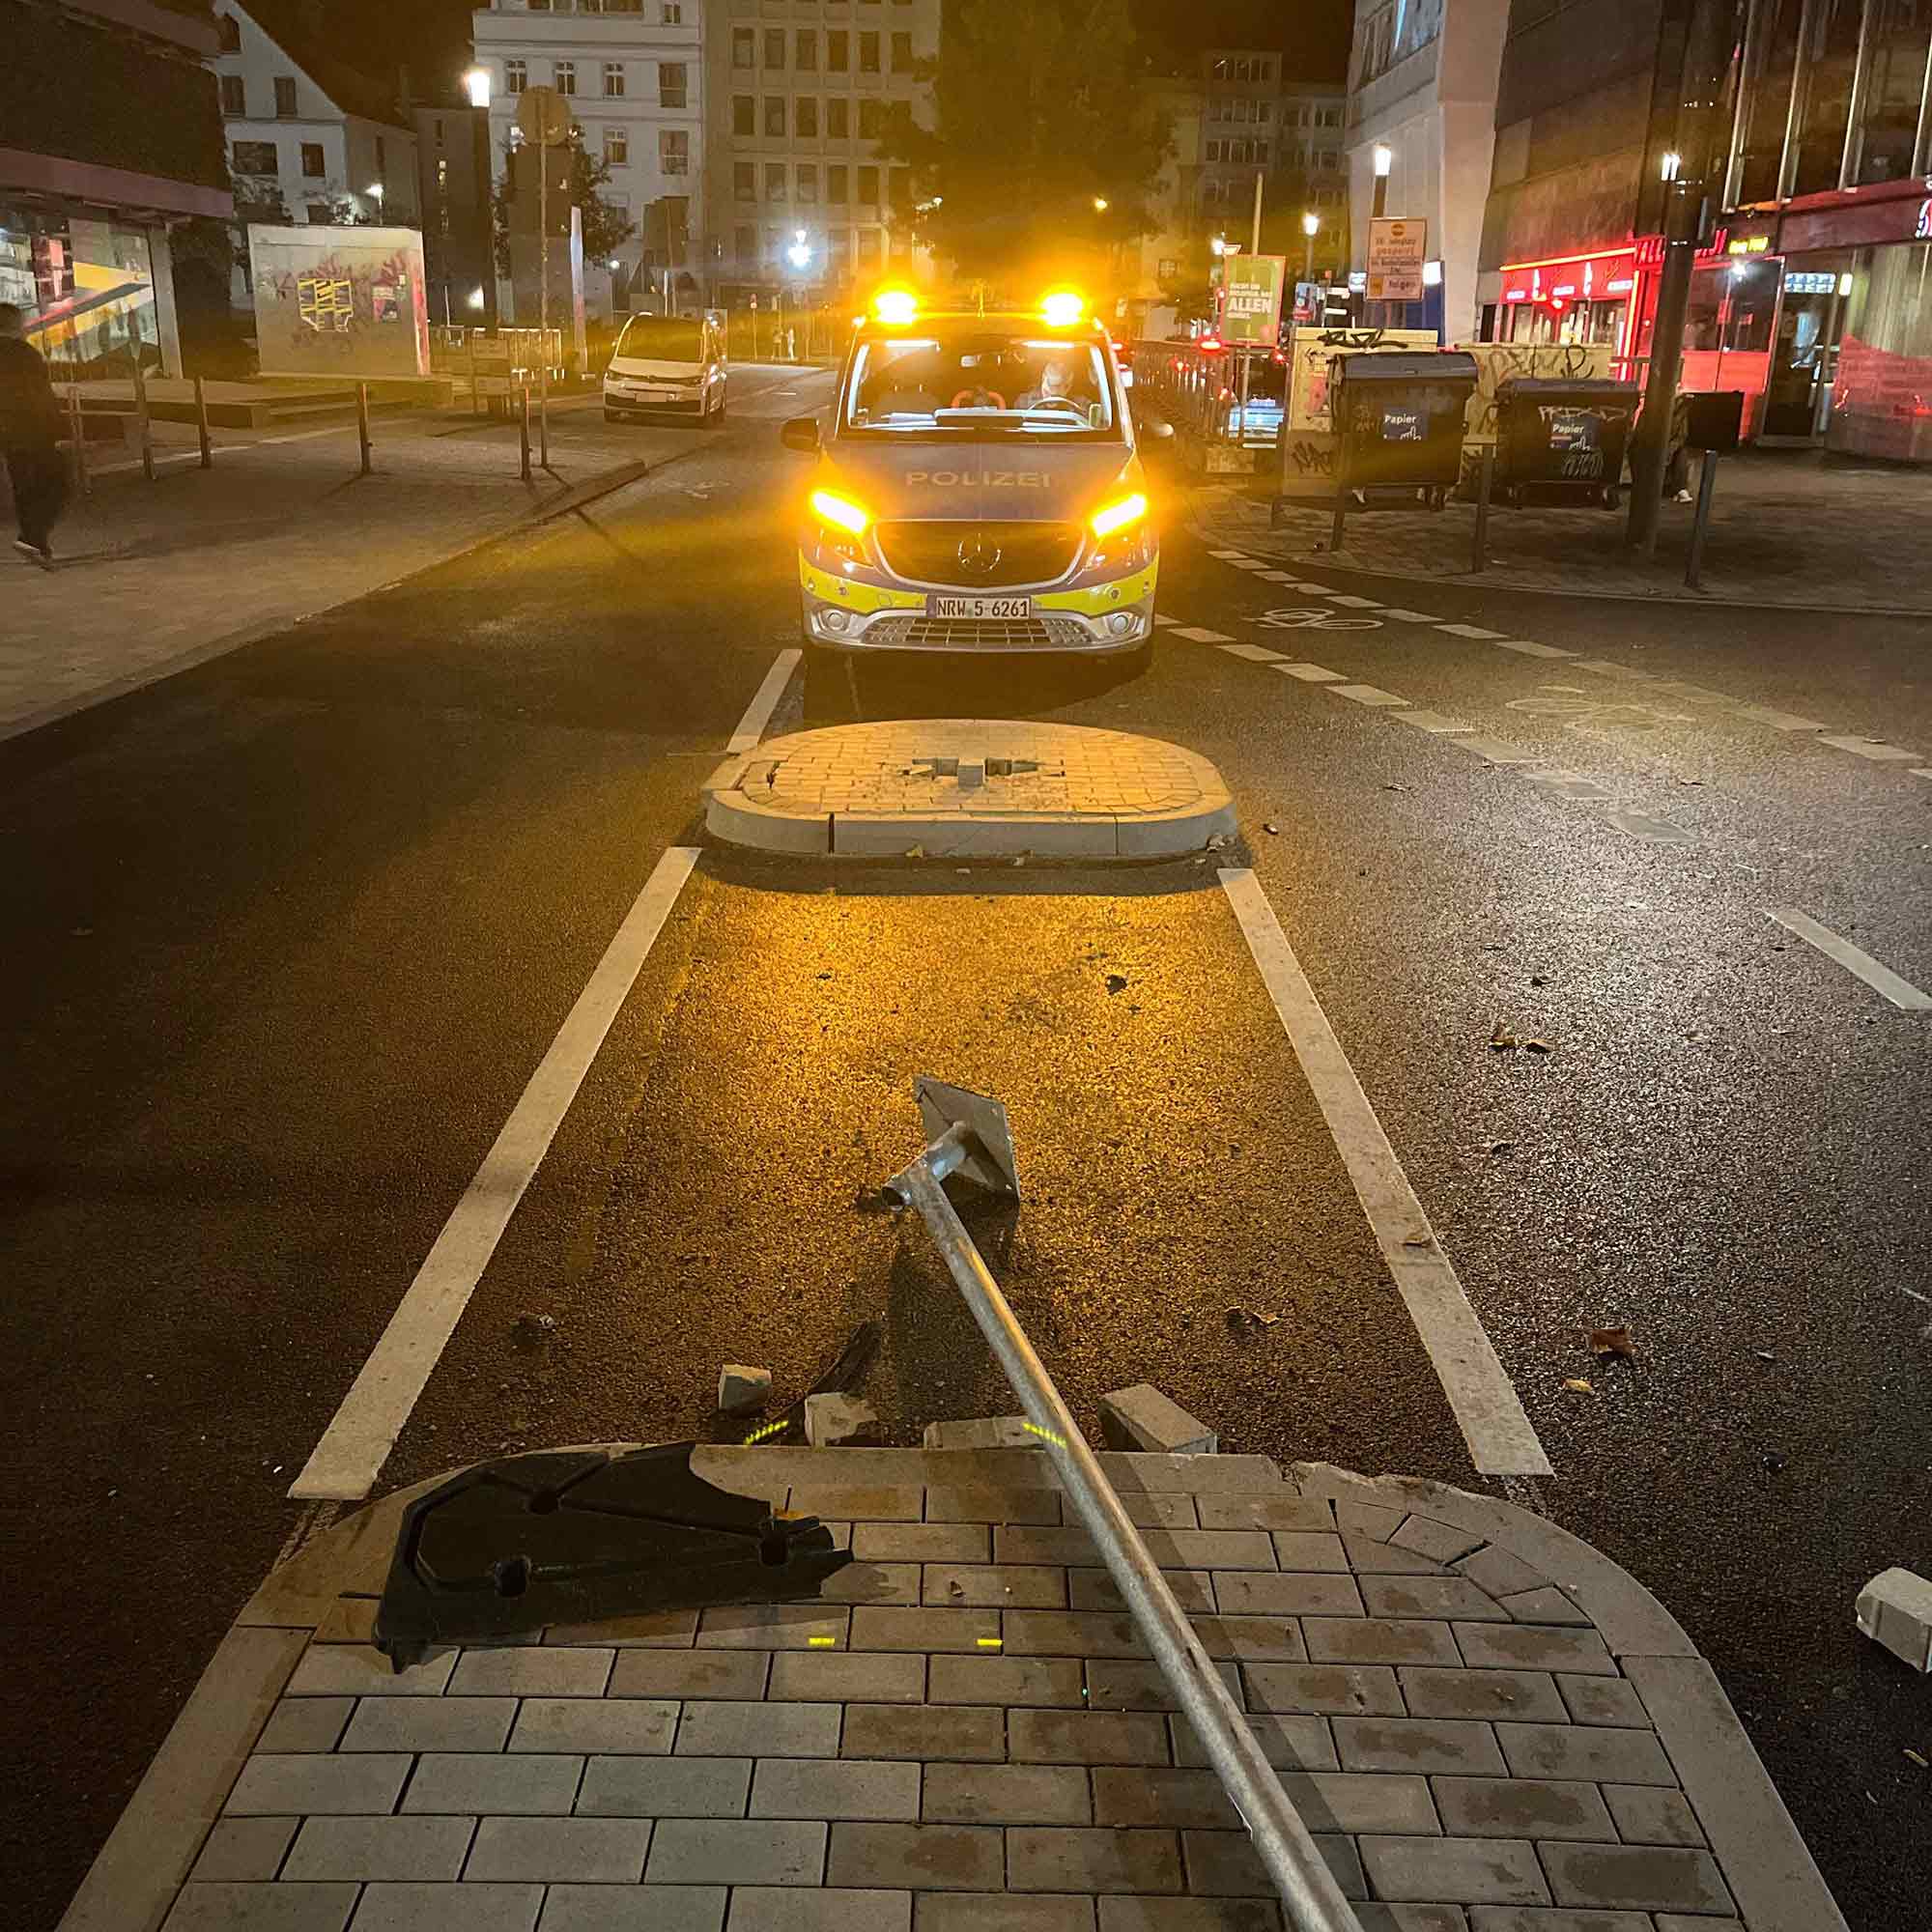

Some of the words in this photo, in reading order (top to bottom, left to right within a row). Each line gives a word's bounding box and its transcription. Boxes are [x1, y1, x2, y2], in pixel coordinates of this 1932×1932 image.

[1228, 297, 1272, 314] ALLEN
[1384, 412, 1416, 425] Papier
[1551, 422, 1585, 435] Papier
[905, 470, 1051, 488] POLIZEI
[936, 599, 966, 617] NRW
